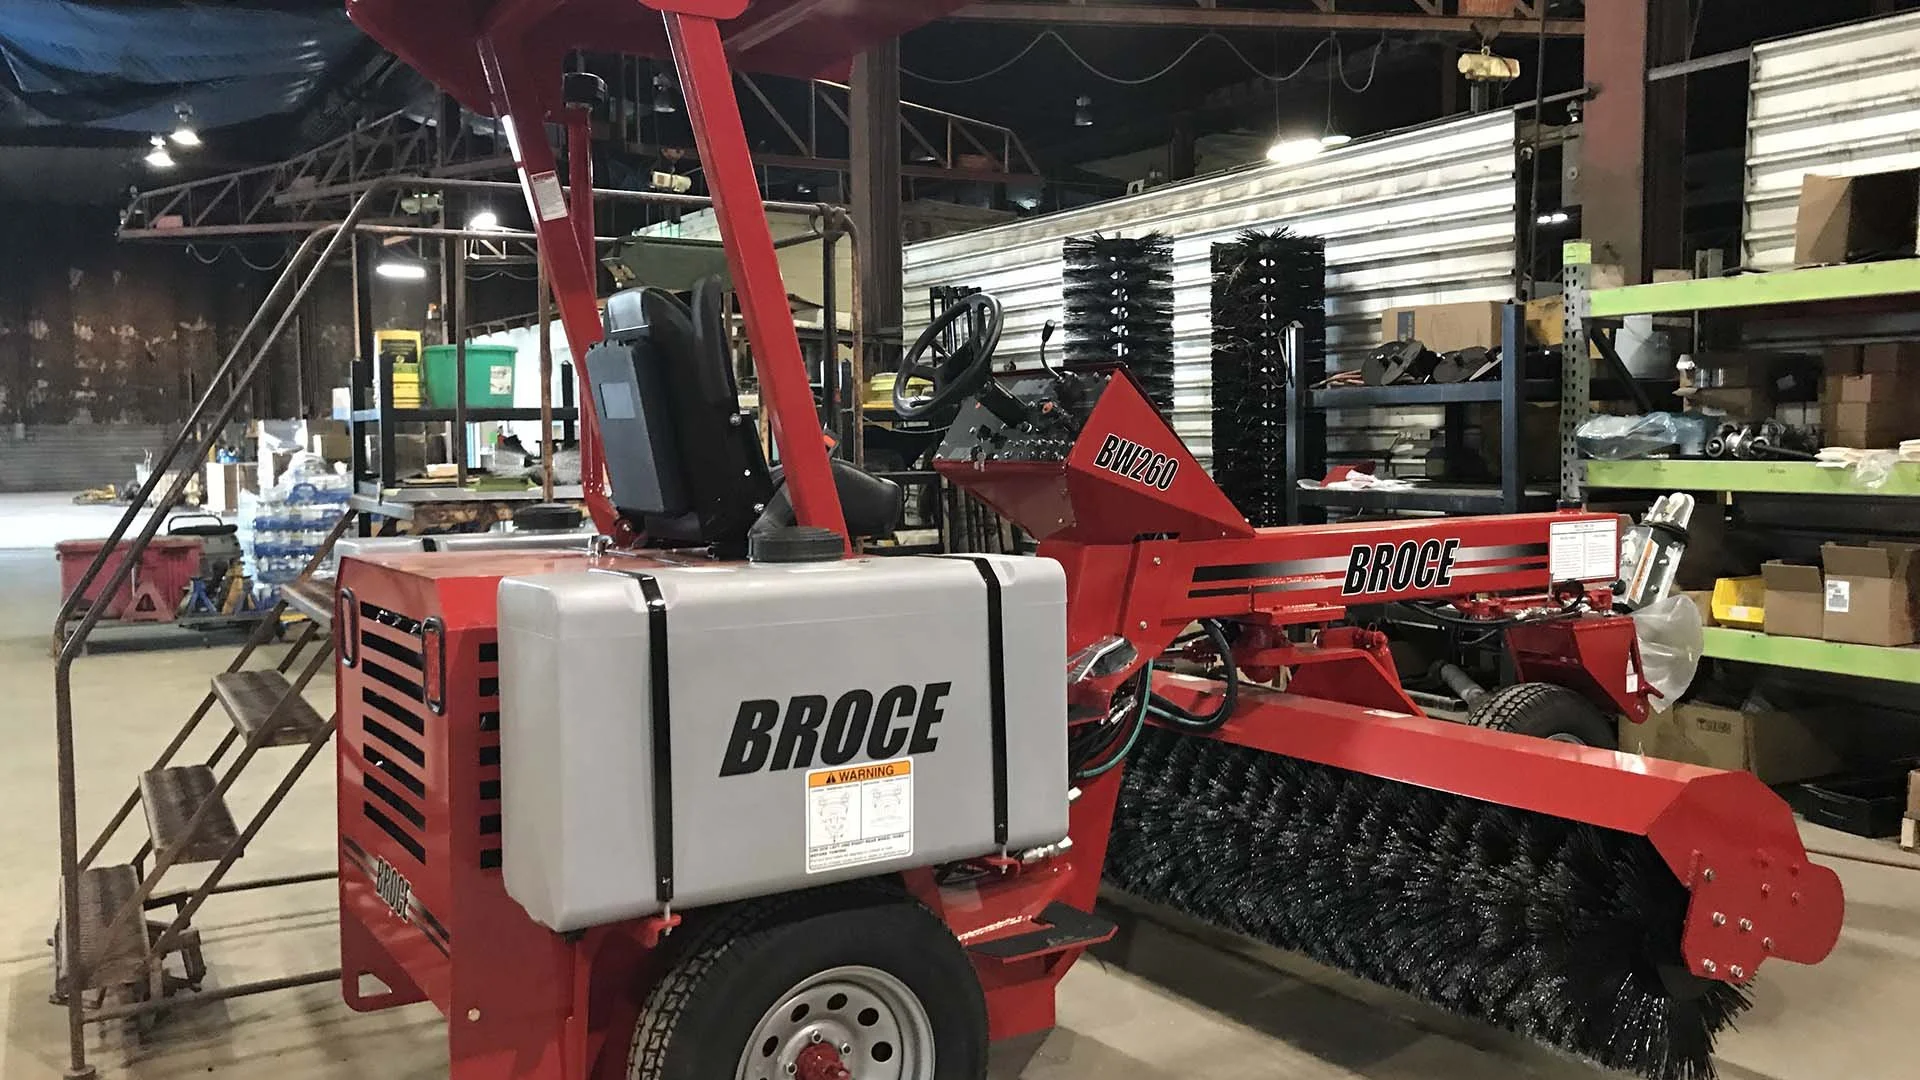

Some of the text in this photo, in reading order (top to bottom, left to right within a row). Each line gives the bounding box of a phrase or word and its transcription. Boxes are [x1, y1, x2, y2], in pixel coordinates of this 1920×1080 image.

[1094, 433, 1179, 491] BW260
[1341, 538, 1460, 596] BROCE
[719, 681, 952, 777] BROCE
[839, 765, 894, 782] WARNING
[376, 855, 411, 924] BROCE
